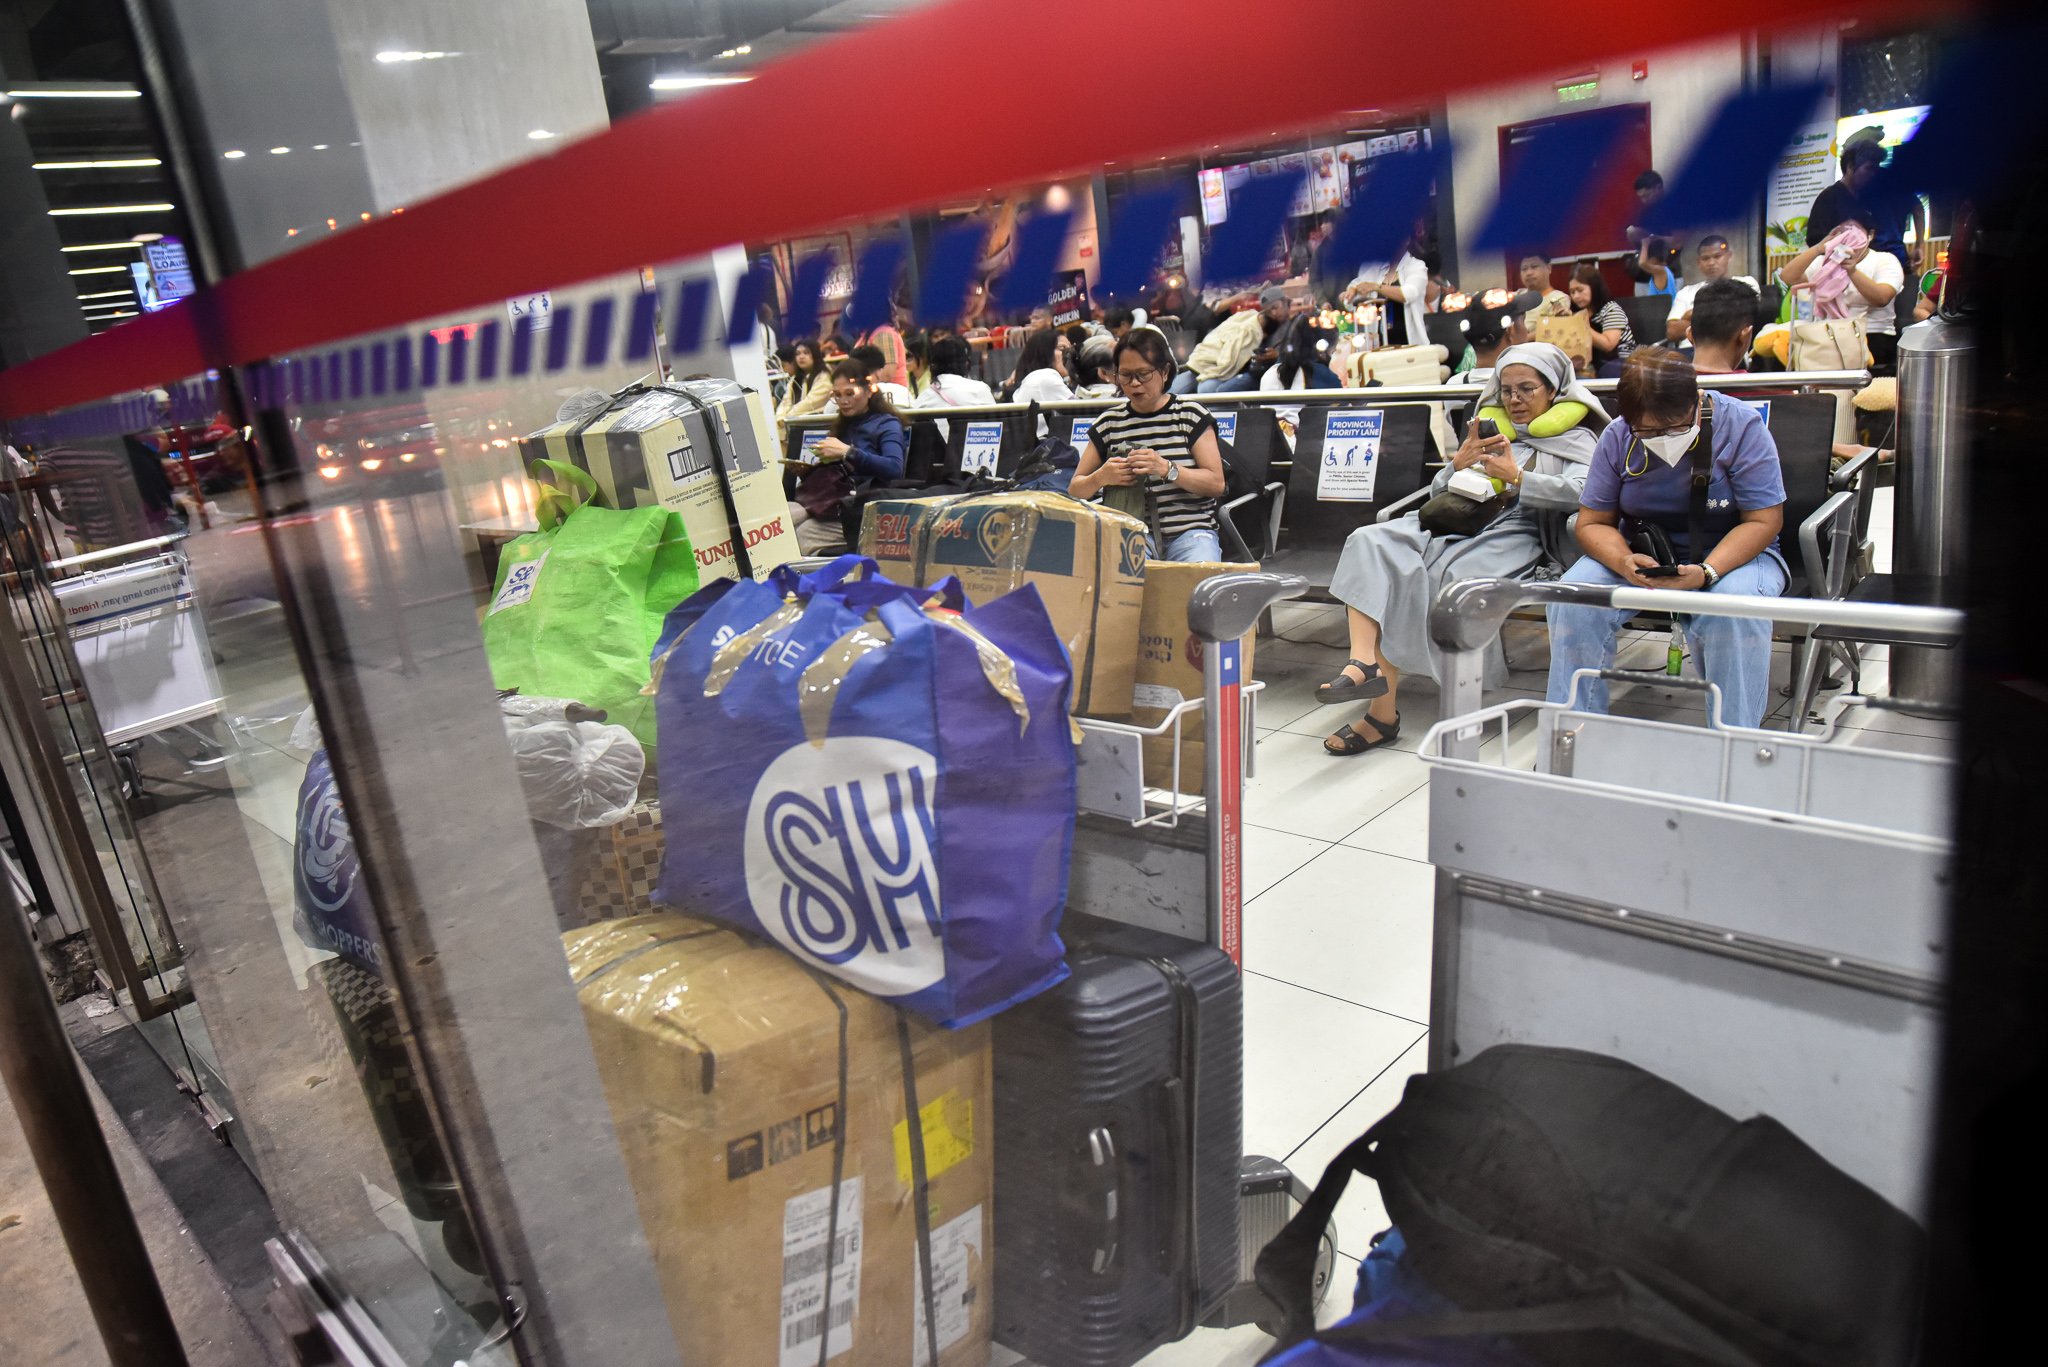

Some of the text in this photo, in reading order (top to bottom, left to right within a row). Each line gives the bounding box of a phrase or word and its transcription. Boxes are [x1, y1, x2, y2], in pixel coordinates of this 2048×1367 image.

[1048, 286, 1077, 305] GOLDEN
[1053, 309, 1080, 327] CHIKIN
[1332, 420, 1375, 429] PROVINCIAL
[1328, 428, 1380, 436] PRIORITY LANE
